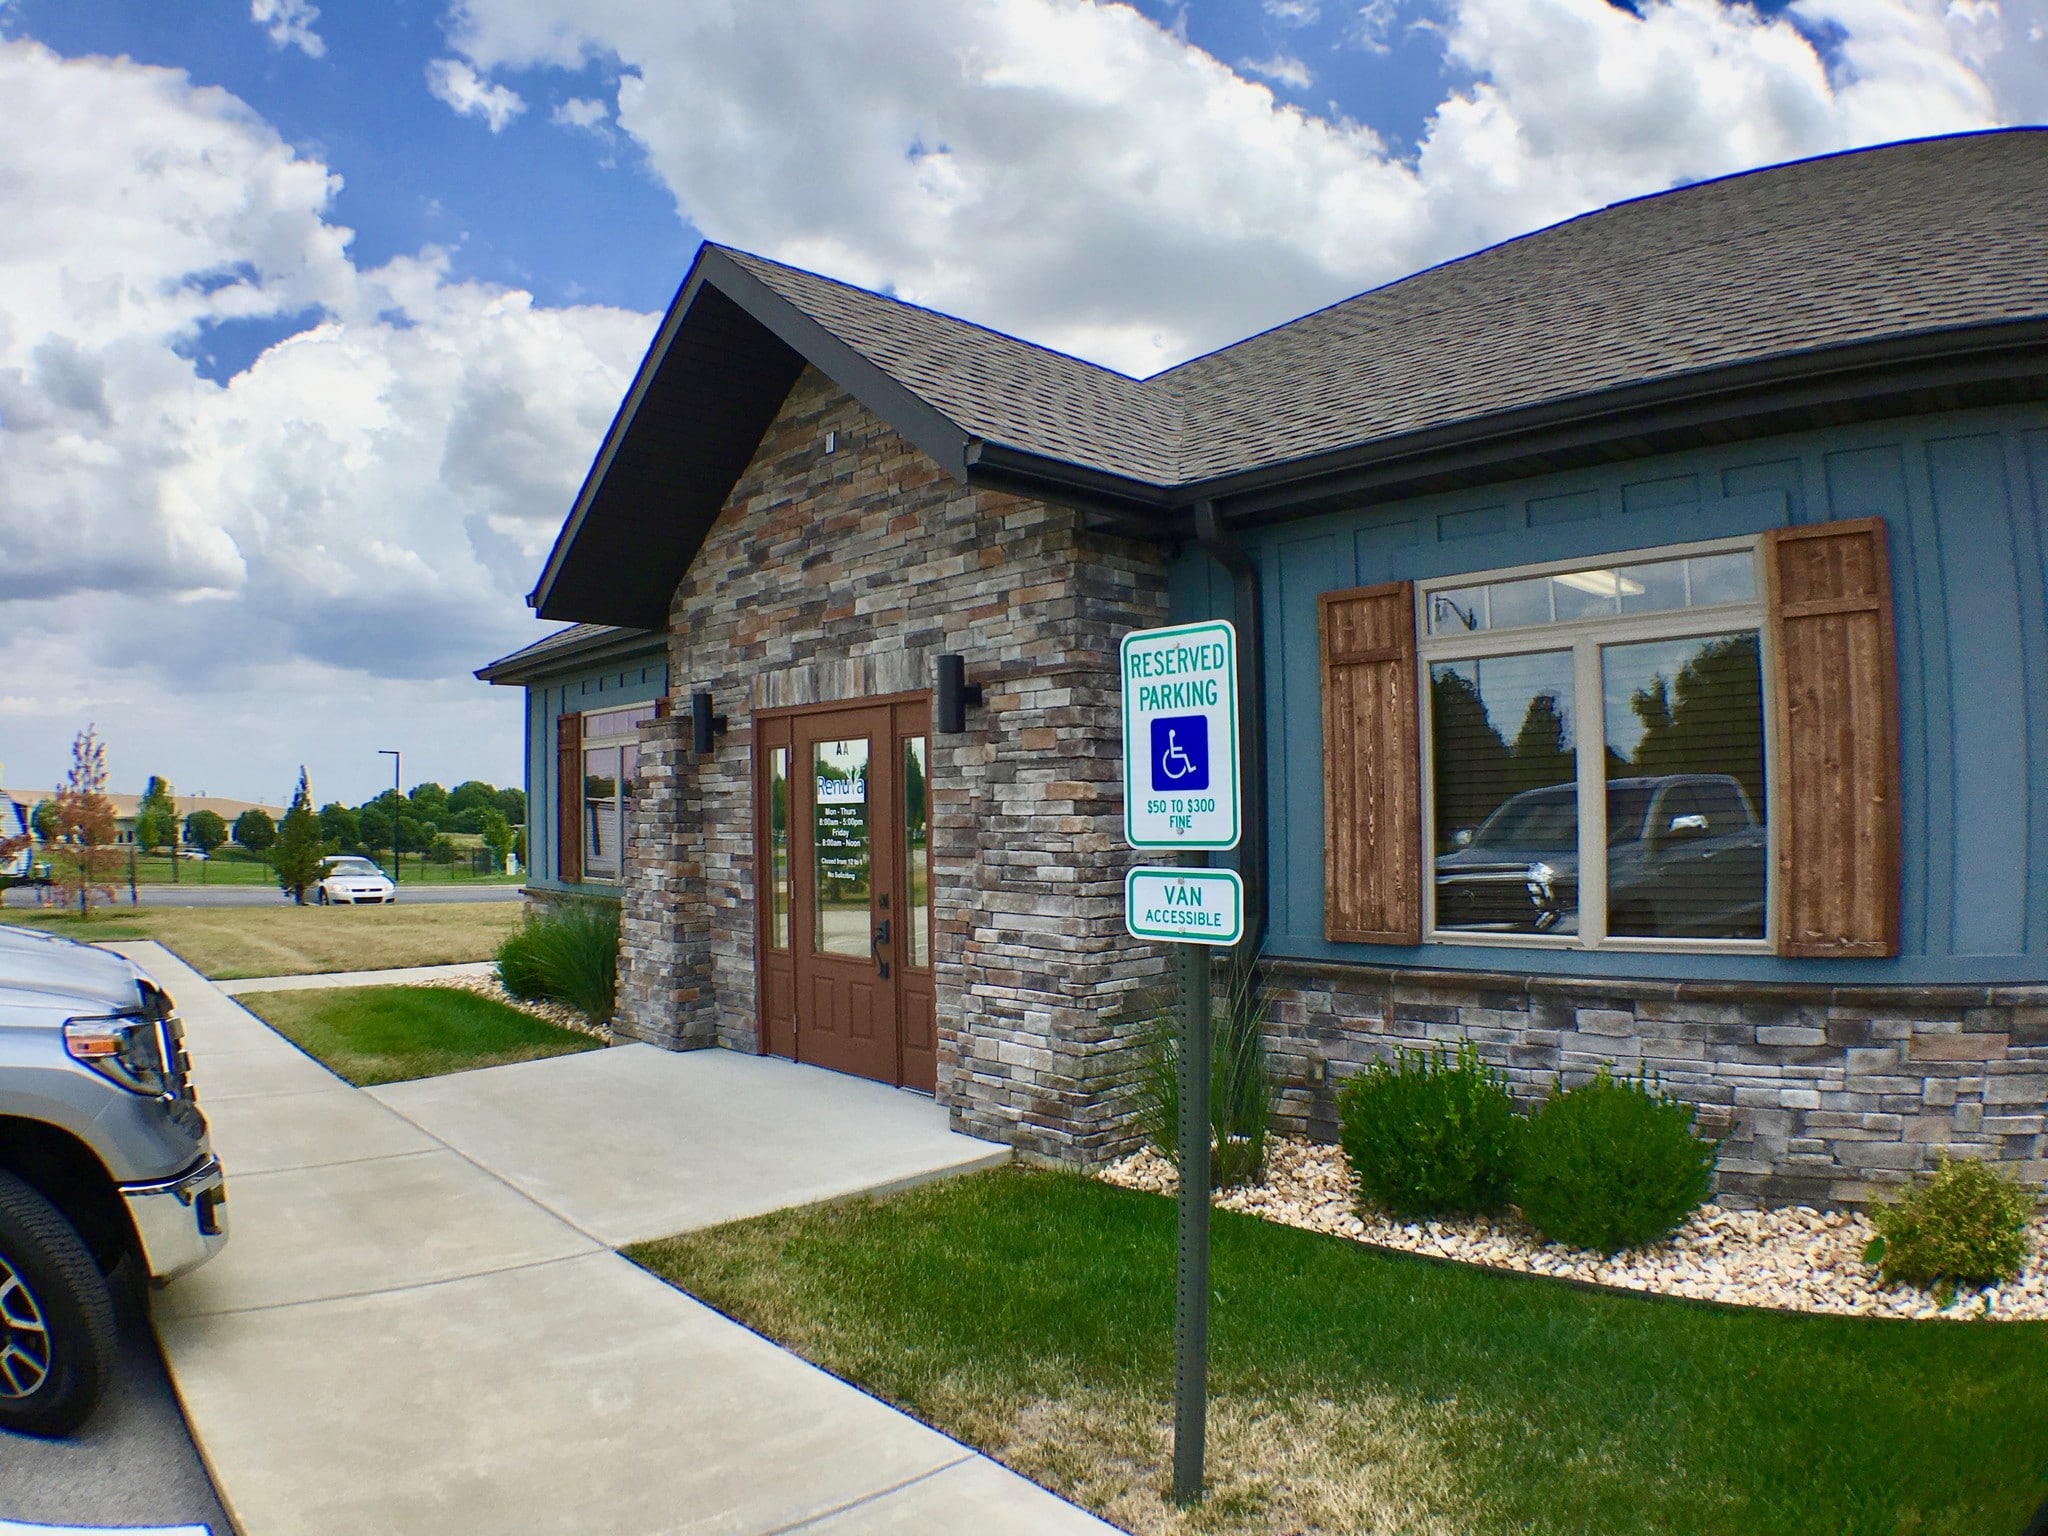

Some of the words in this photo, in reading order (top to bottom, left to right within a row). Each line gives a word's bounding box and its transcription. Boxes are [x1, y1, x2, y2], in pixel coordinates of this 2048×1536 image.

[1131, 643, 1225, 679] RESERVED
[1139, 679, 1218, 712] PARKING
[825, 807, 837, 816] Mon
[840, 807, 857, 815] Thurs
[1147, 800, 1167, 814] $50
[1170, 800, 1184, 813] TO
[1187, 798, 1215, 813] $300
[1169, 815, 1192, 828] FINE
[832, 828, 850, 839] Friday
[846, 838, 862, 847] Noon
[1164, 885, 1202, 907] VAN
[1145, 909, 1222, 927] ACCESSIBLE
